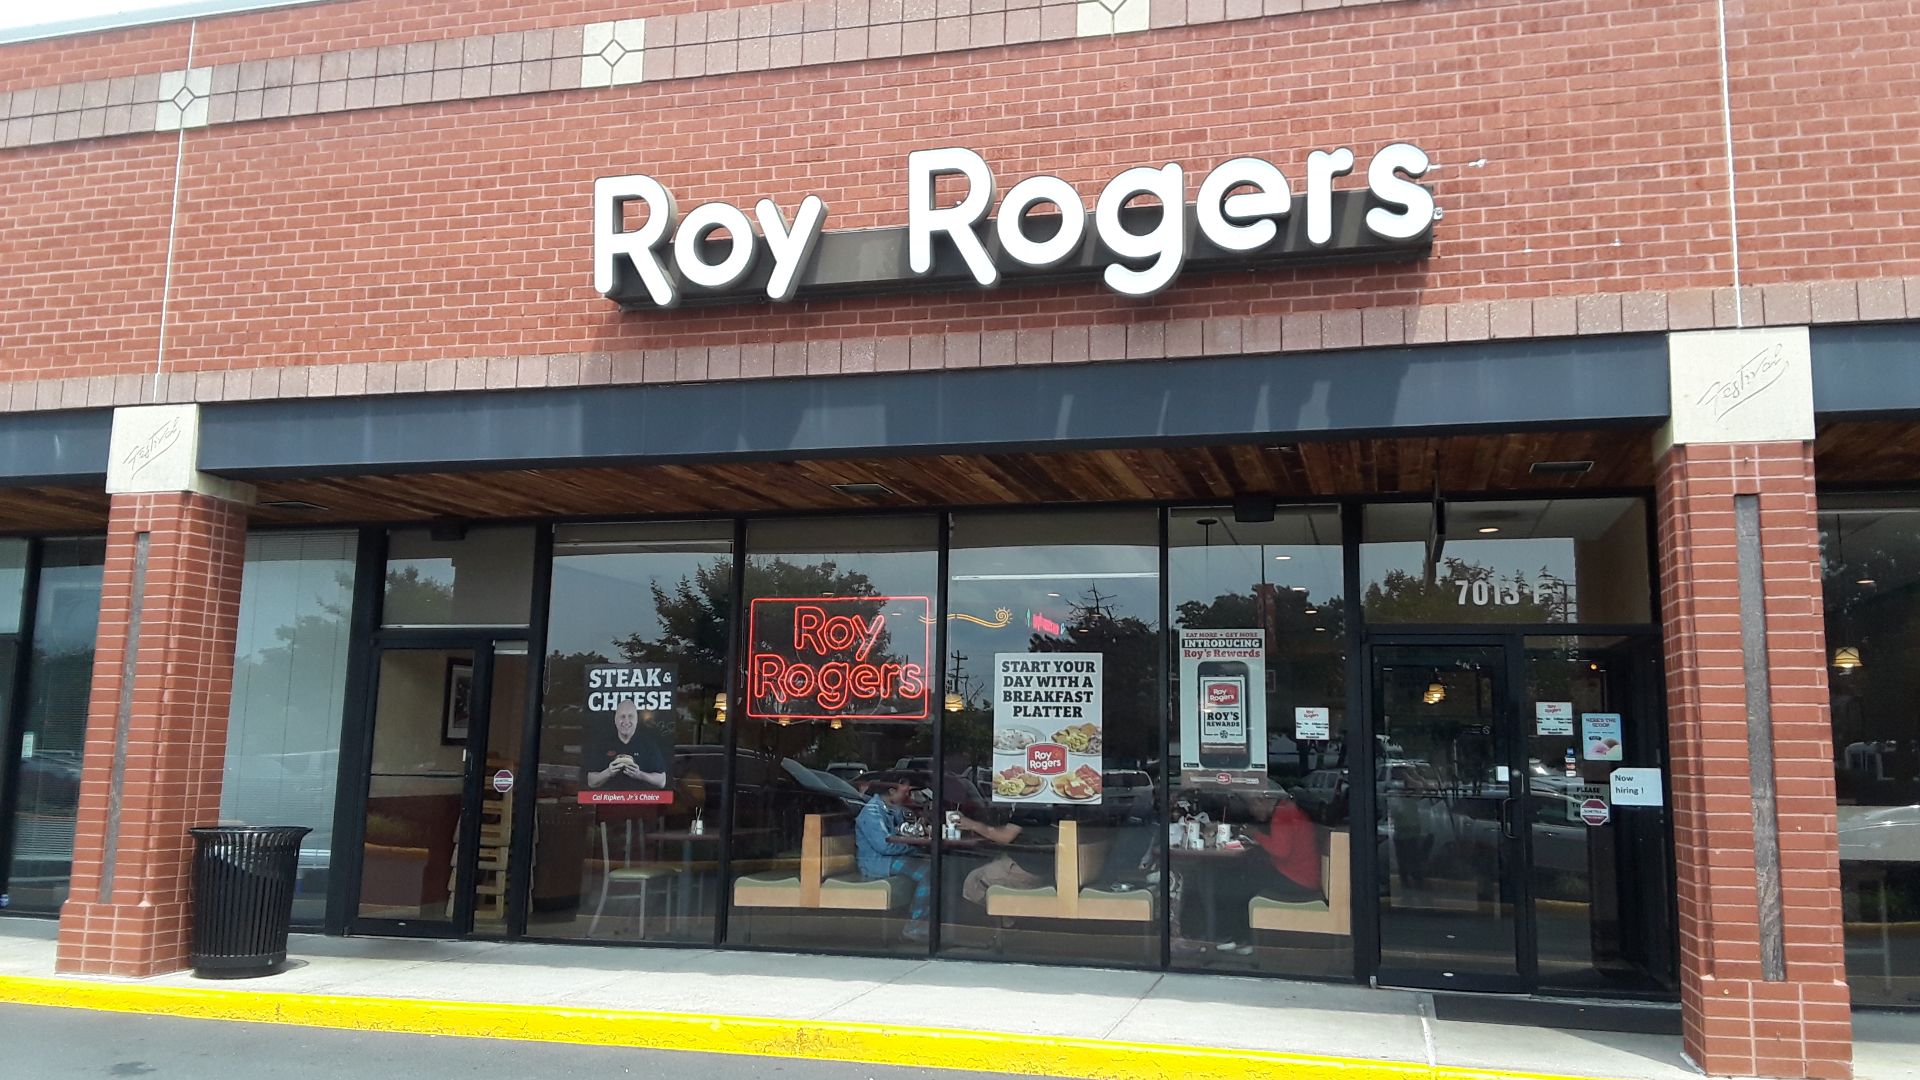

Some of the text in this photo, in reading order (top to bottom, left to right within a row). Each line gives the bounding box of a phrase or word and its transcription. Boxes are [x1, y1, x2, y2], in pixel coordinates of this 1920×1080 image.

[594, 141, 1434, 306] Roy Rogers
[794, 605, 885, 662] Roy
[1184, 639, 1260, 648] INTRODUCING
[1184, 649, 1261, 660] Roy's Rewards
[1001, 661, 1096, 673] START YOUR
[589, 668, 662, 688] STEAK
[754, 653, 924, 711] Rogers
[1003, 676, 1093, 688] DAY WITH A
[1002, 690, 1094, 703] BREAKFAST
[1209, 694, 1235, 702] Rogers
[1213, 688, 1226, 696] Roy
[588, 691, 672, 712] CHEESE
[1012, 705, 1083, 718] PLATTER
[1207, 712, 1240, 721] ROY'S
[1034, 750, 1053, 761] Roy
[1029, 758, 1062, 771] Rogers
[1614, 774, 1634, 782] Now
[1615, 787, 1639, 796] hiring
